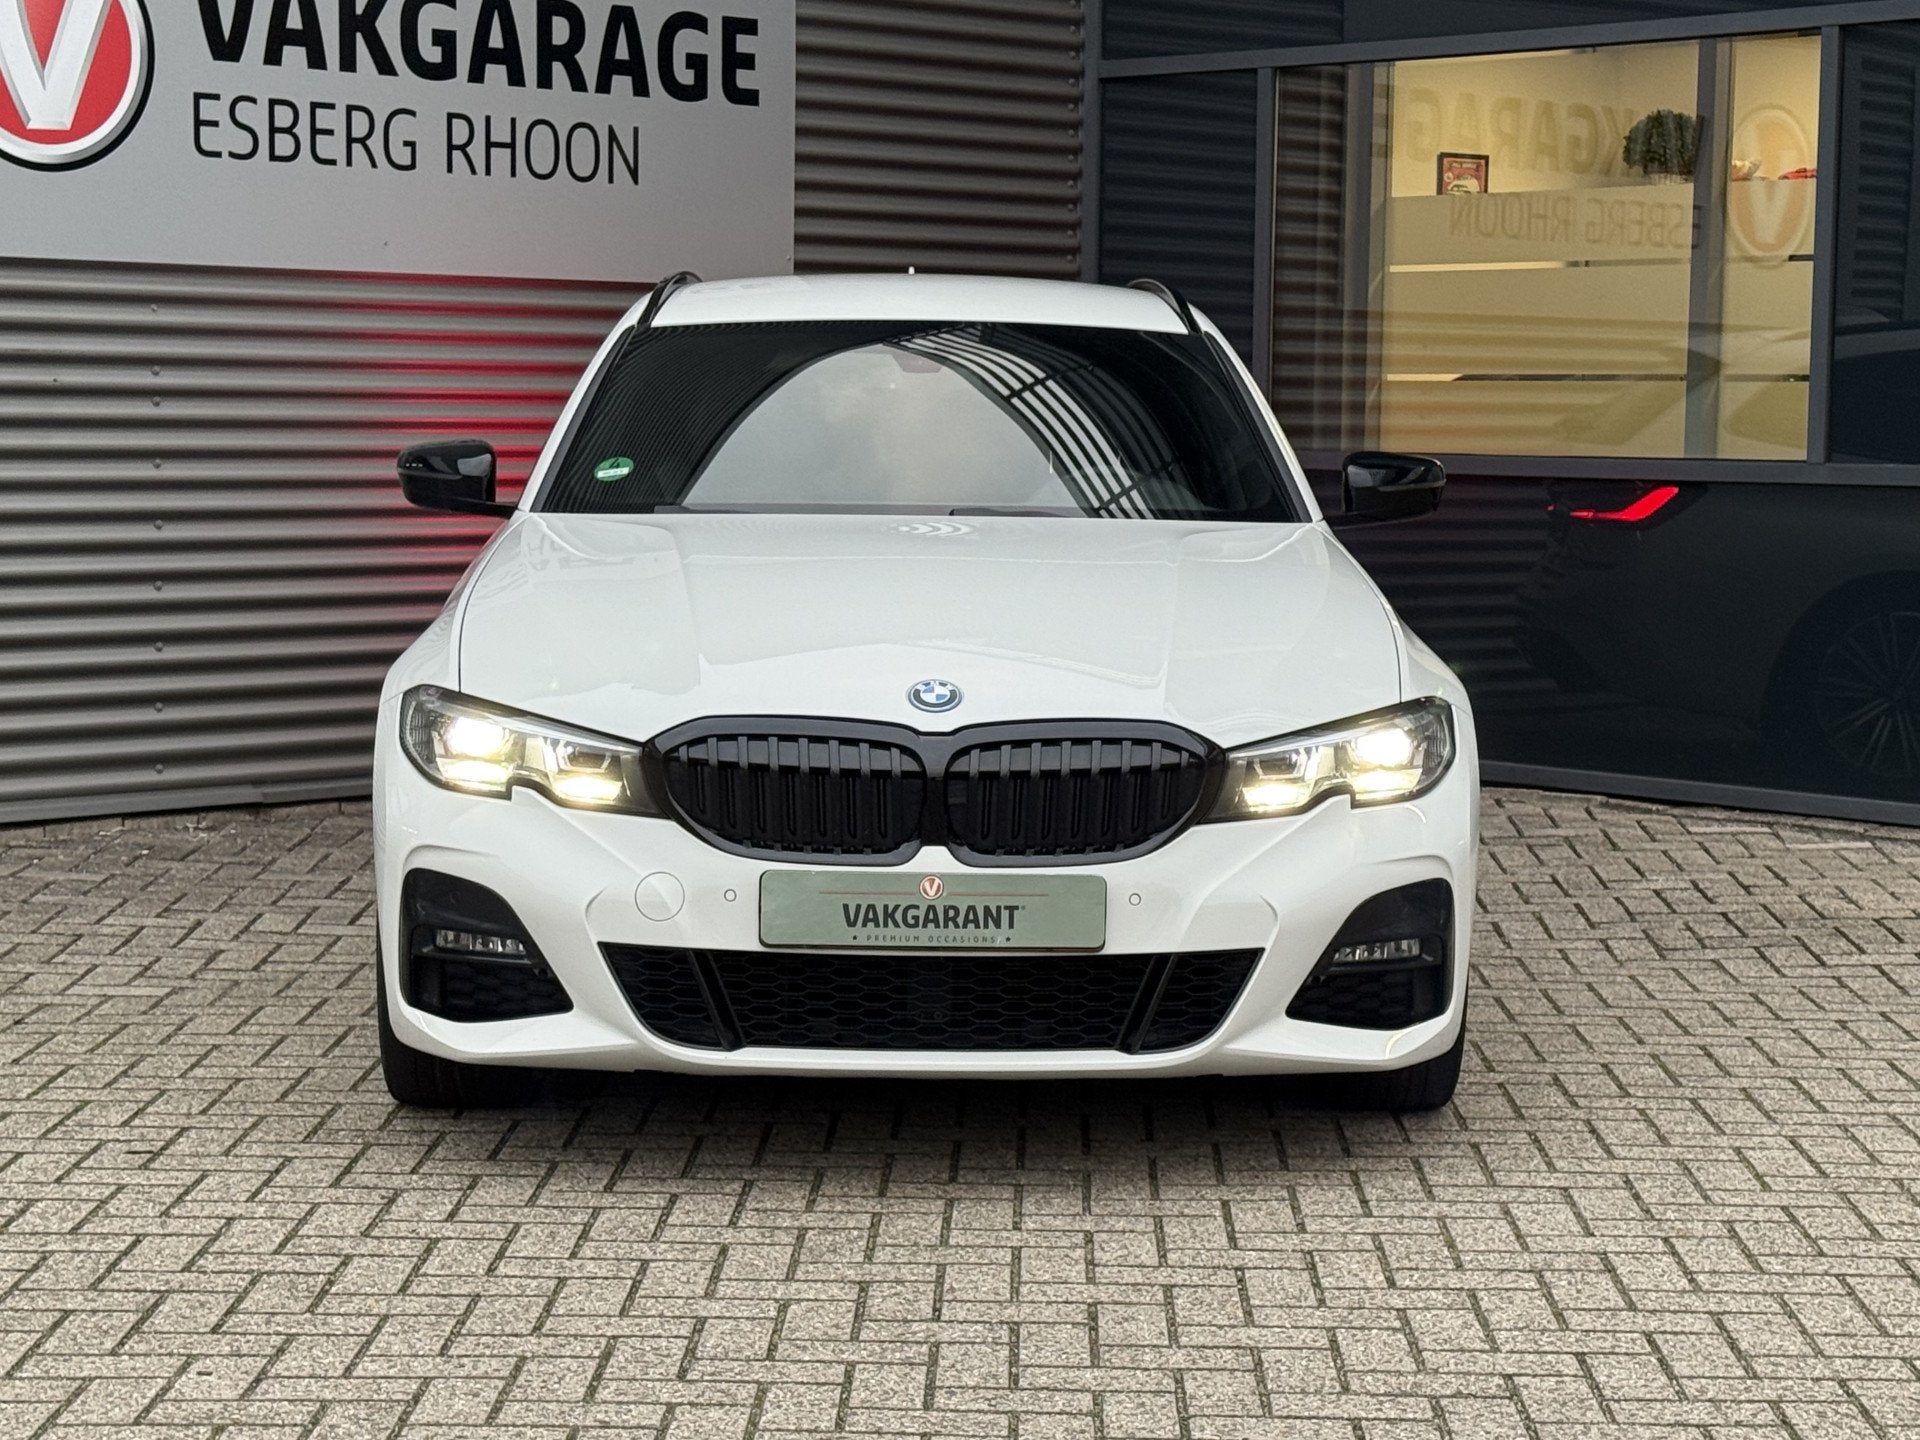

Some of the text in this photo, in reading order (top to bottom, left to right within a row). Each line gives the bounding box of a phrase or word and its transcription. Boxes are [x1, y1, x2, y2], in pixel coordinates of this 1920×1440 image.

[197, 0, 760, 107] VAKGARAGE
[193, 91, 639, 186] ESBERG RHOON
[924, 880, 940, 897] V
[842, 902, 1020, 930] VAKGARANT
[866, 934, 996, 944] PREMIUM OCCASIONS
